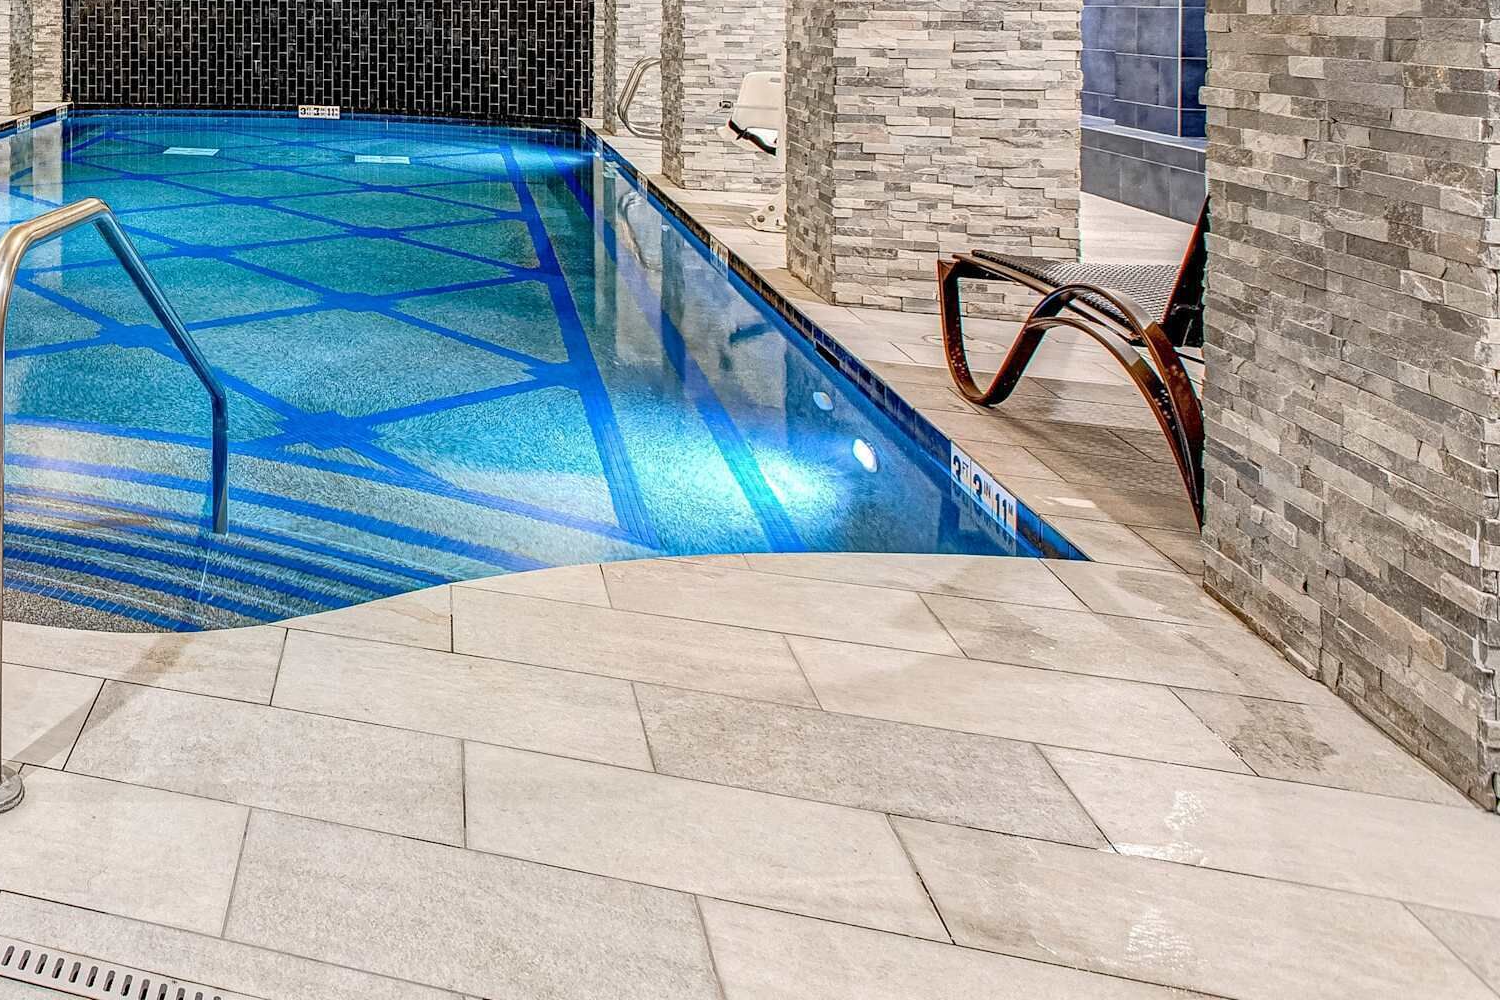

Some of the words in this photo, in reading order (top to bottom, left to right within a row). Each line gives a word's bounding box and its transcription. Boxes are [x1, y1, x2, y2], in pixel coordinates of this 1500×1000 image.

[953, 455, 961, 482] 3
[962, 461, 969, 476] FT
[983, 479, 992, 500] IN
